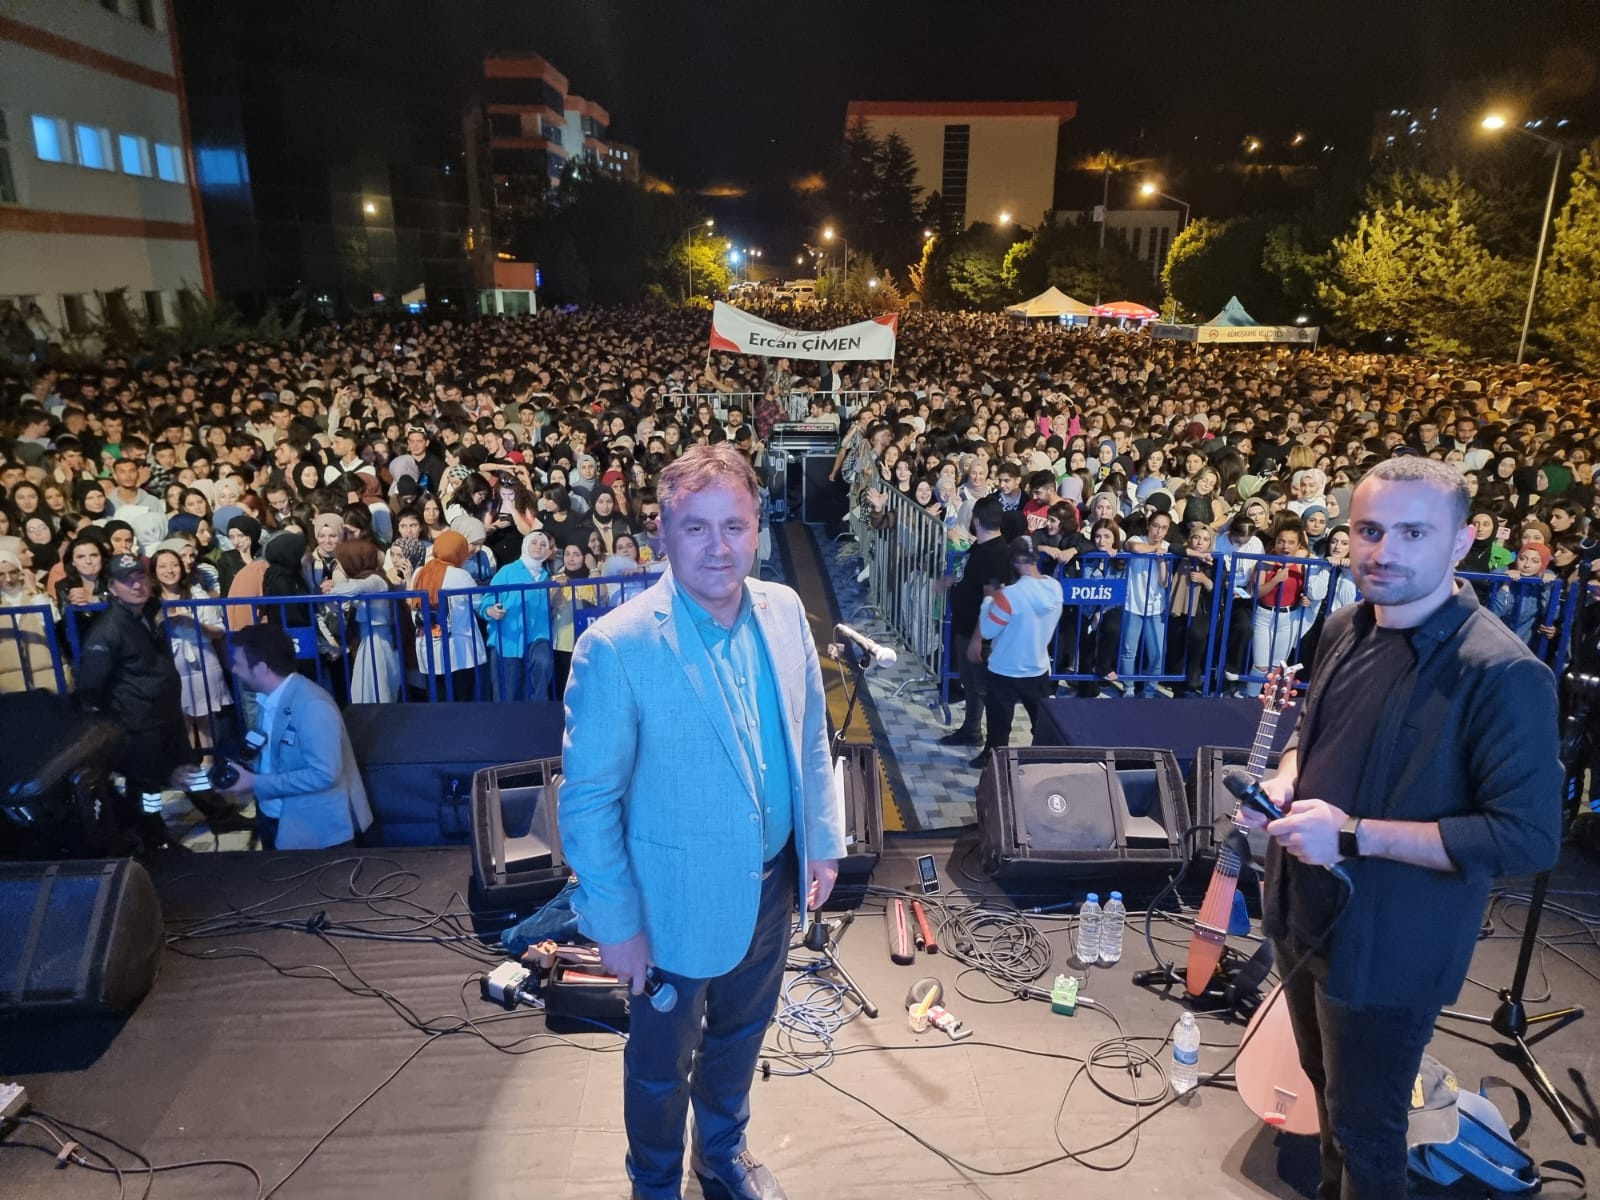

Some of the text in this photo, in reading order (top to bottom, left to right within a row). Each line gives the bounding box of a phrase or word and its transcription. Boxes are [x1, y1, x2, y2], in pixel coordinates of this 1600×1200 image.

[749, 332, 797, 350] Ercan
[802, 335, 861, 352] ÇİMEN
[1071, 585, 1112, 600] POLİS
